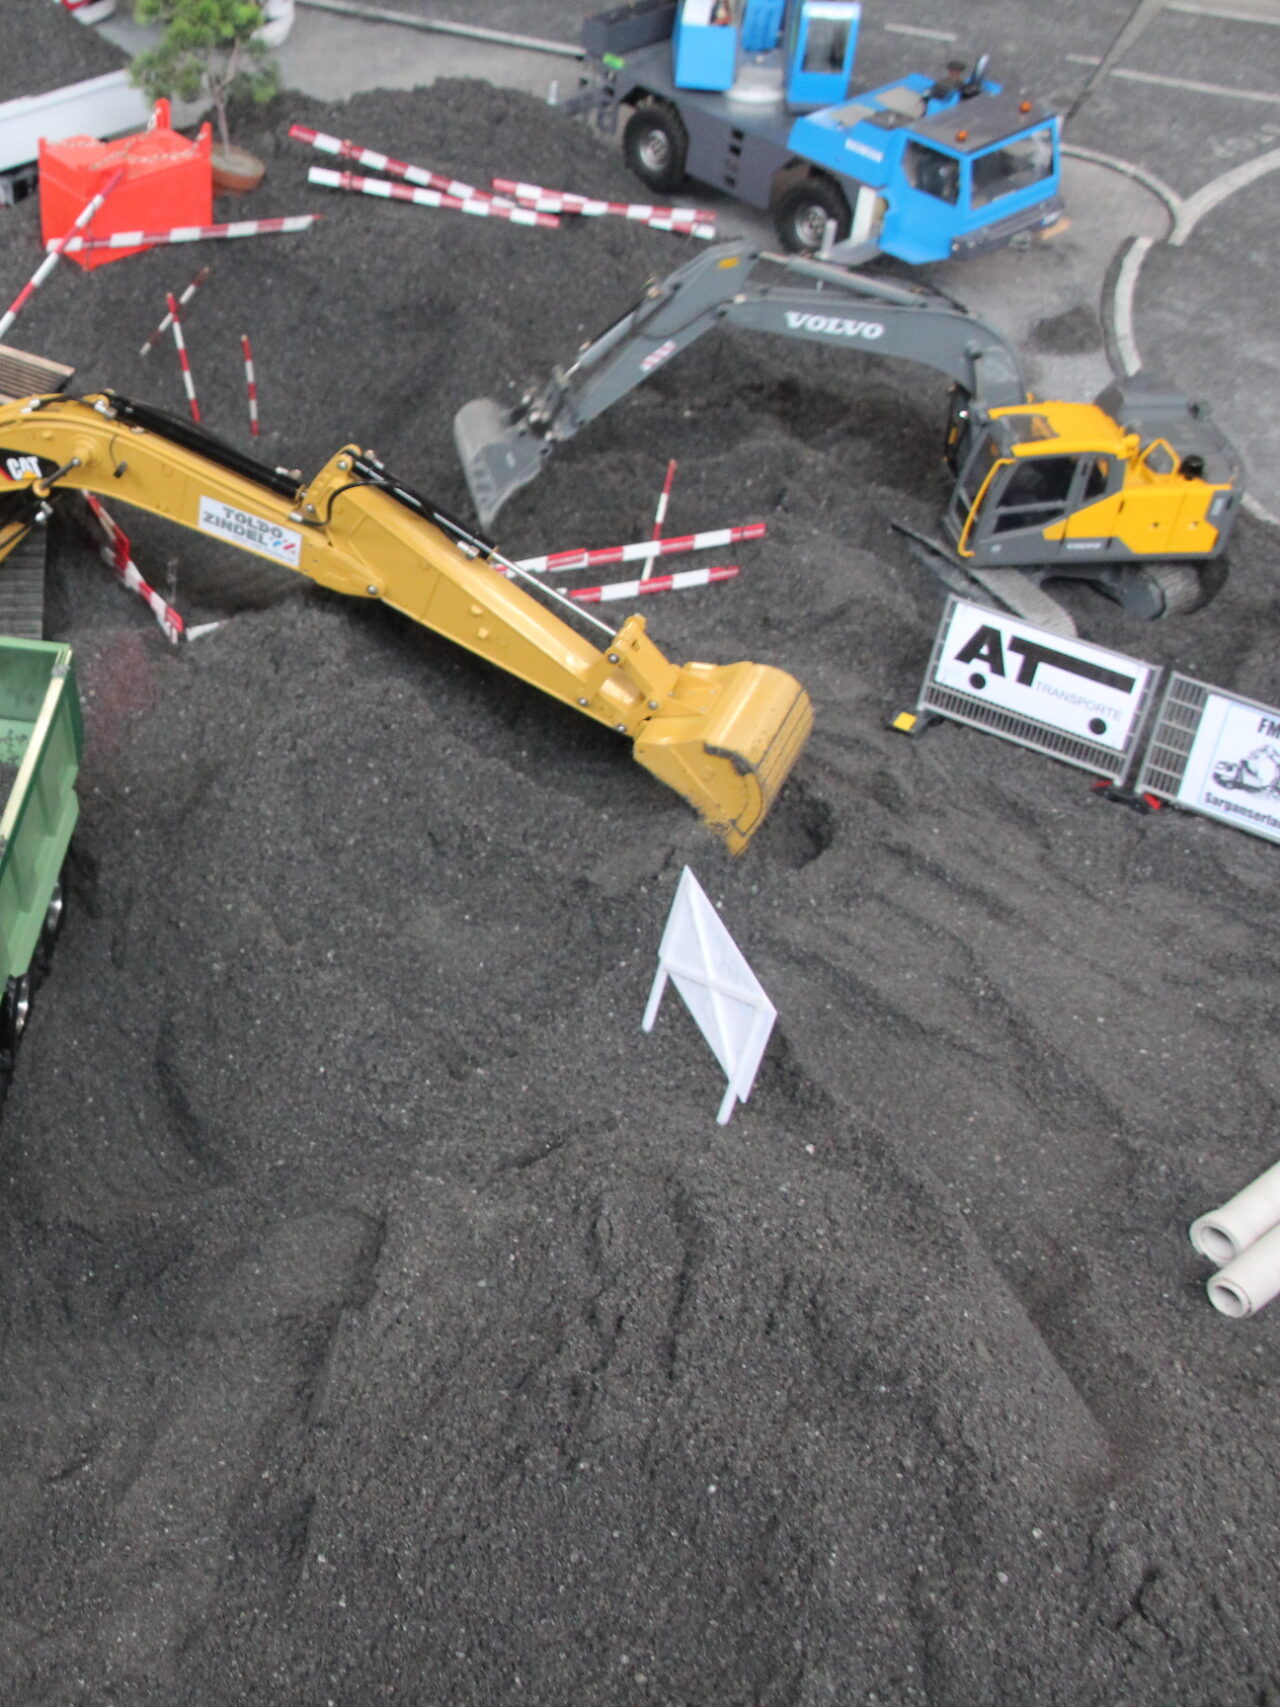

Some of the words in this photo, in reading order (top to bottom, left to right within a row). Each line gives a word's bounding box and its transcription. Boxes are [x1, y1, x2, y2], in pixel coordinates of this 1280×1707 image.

[784, 310, 884, 339] VOLVO
[6, 456, 42, 480] CAT
[203, 510, 268, 546] ZINDEL
[222, 505, 283, 538] TOLDO
[954, 624, 1136, 695] AT
[1036, 681, 1123, 721] TRANSPORTE
